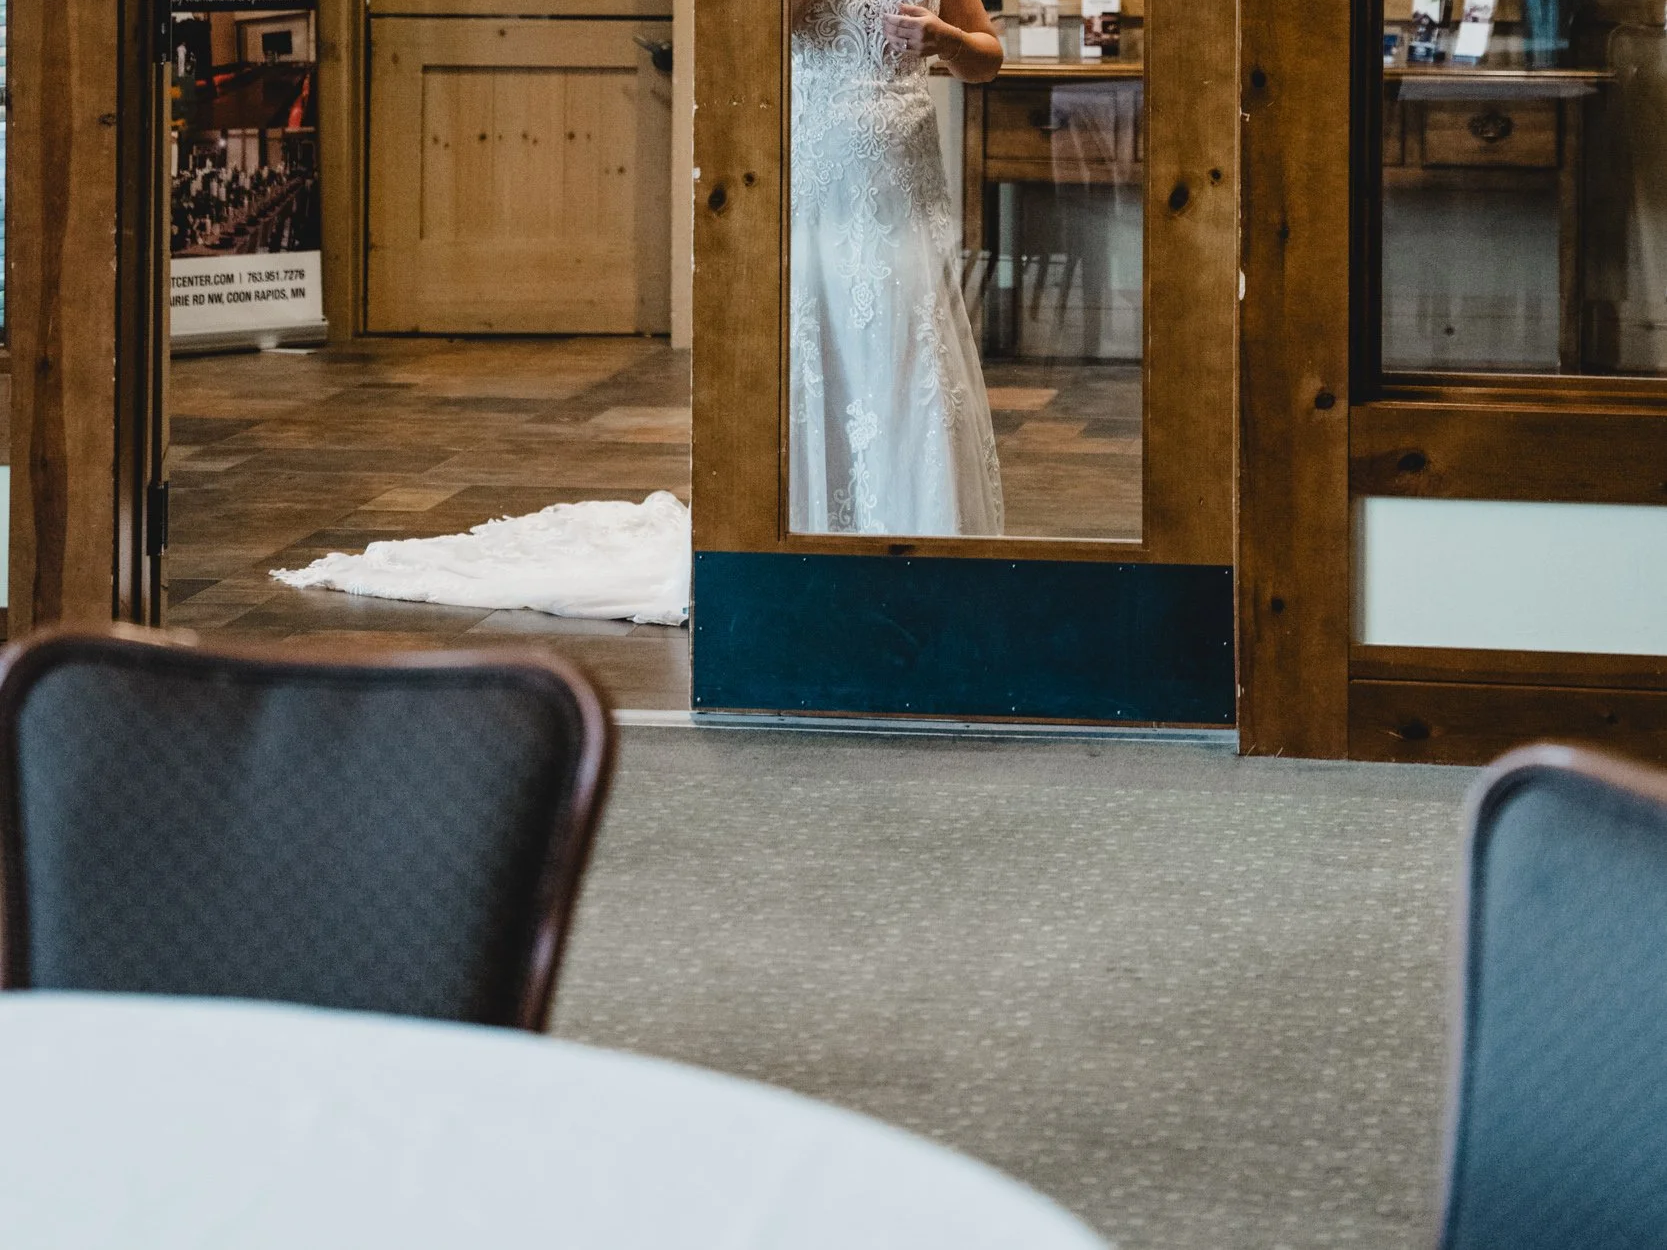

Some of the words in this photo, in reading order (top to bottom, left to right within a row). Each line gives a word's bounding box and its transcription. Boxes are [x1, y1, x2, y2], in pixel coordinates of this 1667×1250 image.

[192, 293, 206, 306] RD
[226, 290, 252, 304] COON
[291, 286, 306, 299] MN
